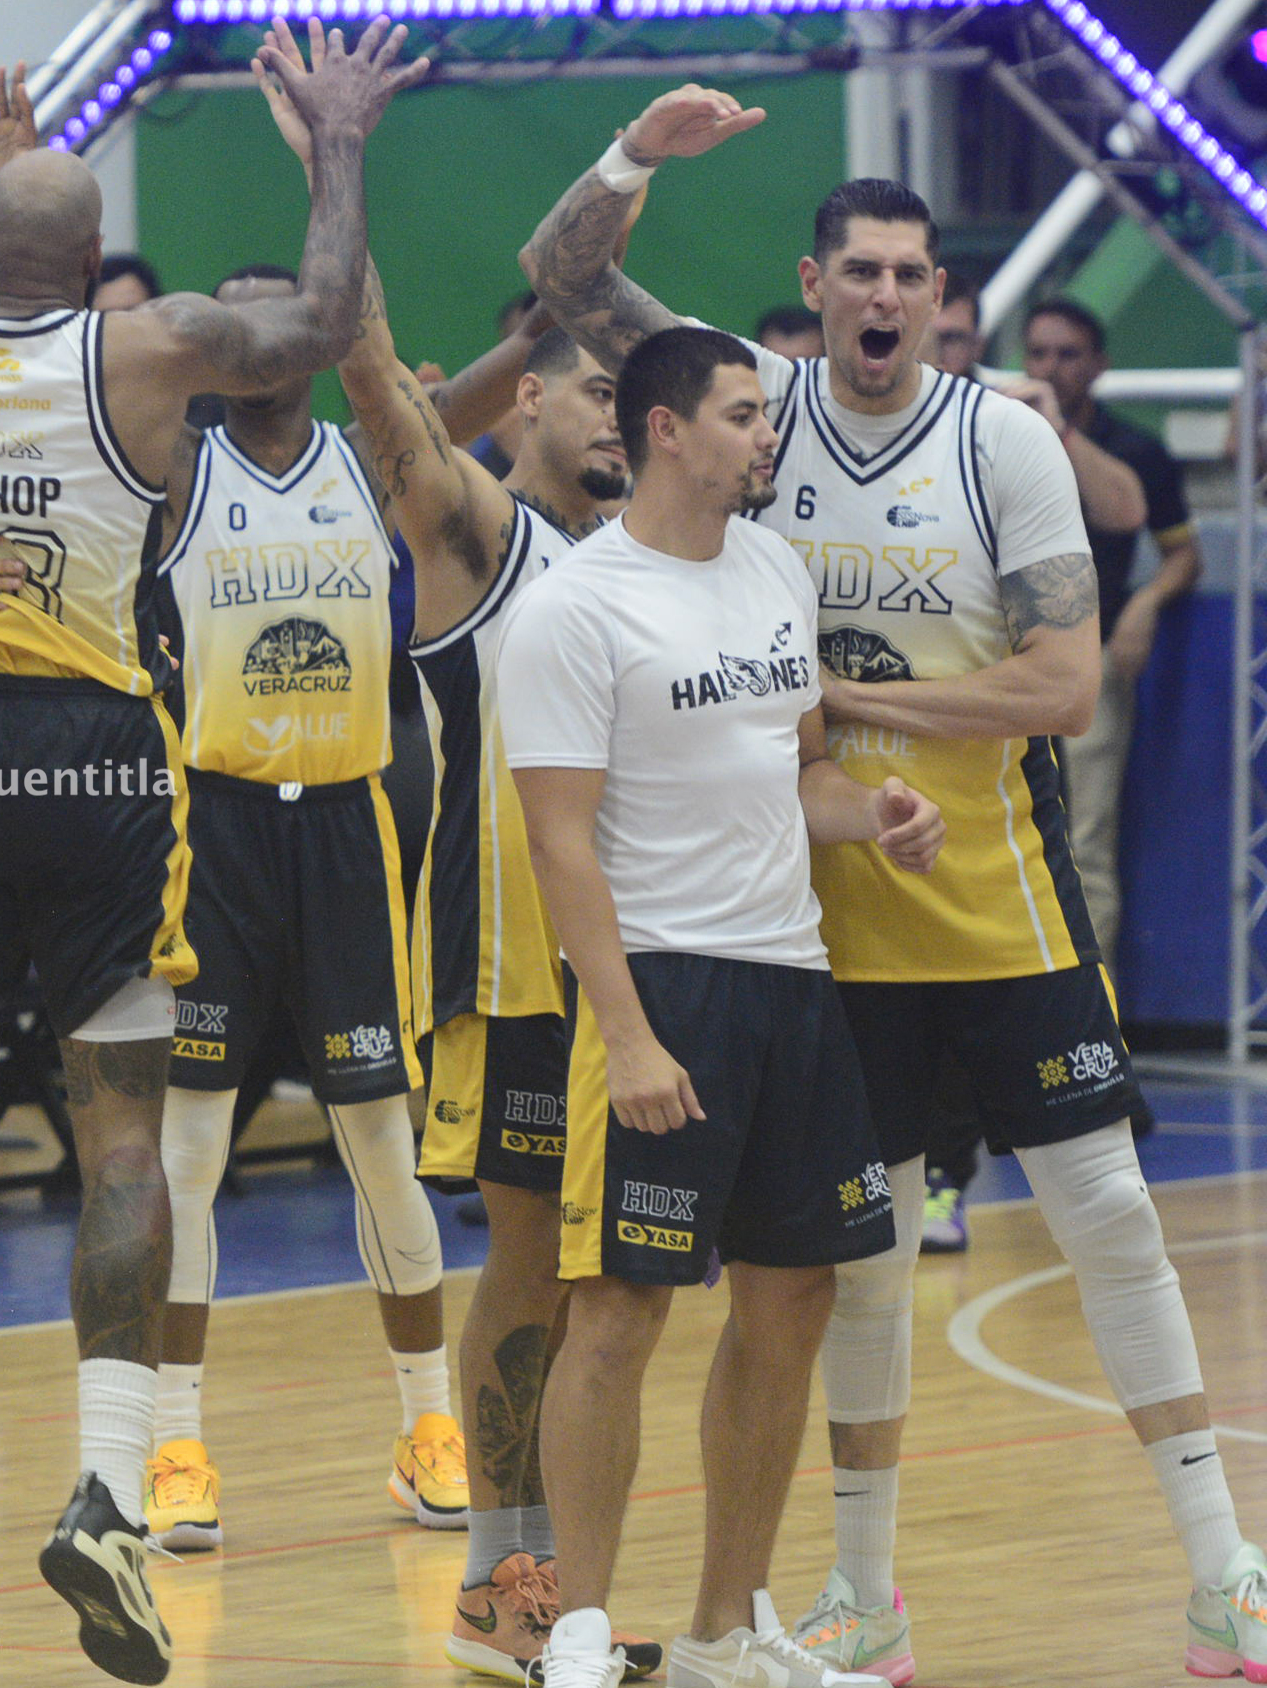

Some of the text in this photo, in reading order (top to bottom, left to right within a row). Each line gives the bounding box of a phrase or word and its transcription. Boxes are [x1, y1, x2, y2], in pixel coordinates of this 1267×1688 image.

[228, 502, 247, 531] 0
[795, 485, 816, 520] 6
[205, 539, 372, 609] HDX
[243, 674, 353, 697] VERACRUZ
[1067, 1039, 1113, 1065] VERA
[1073, 1055, 1119, 1080] CRUZ
[621, 1179, 699, 1222] HDX
